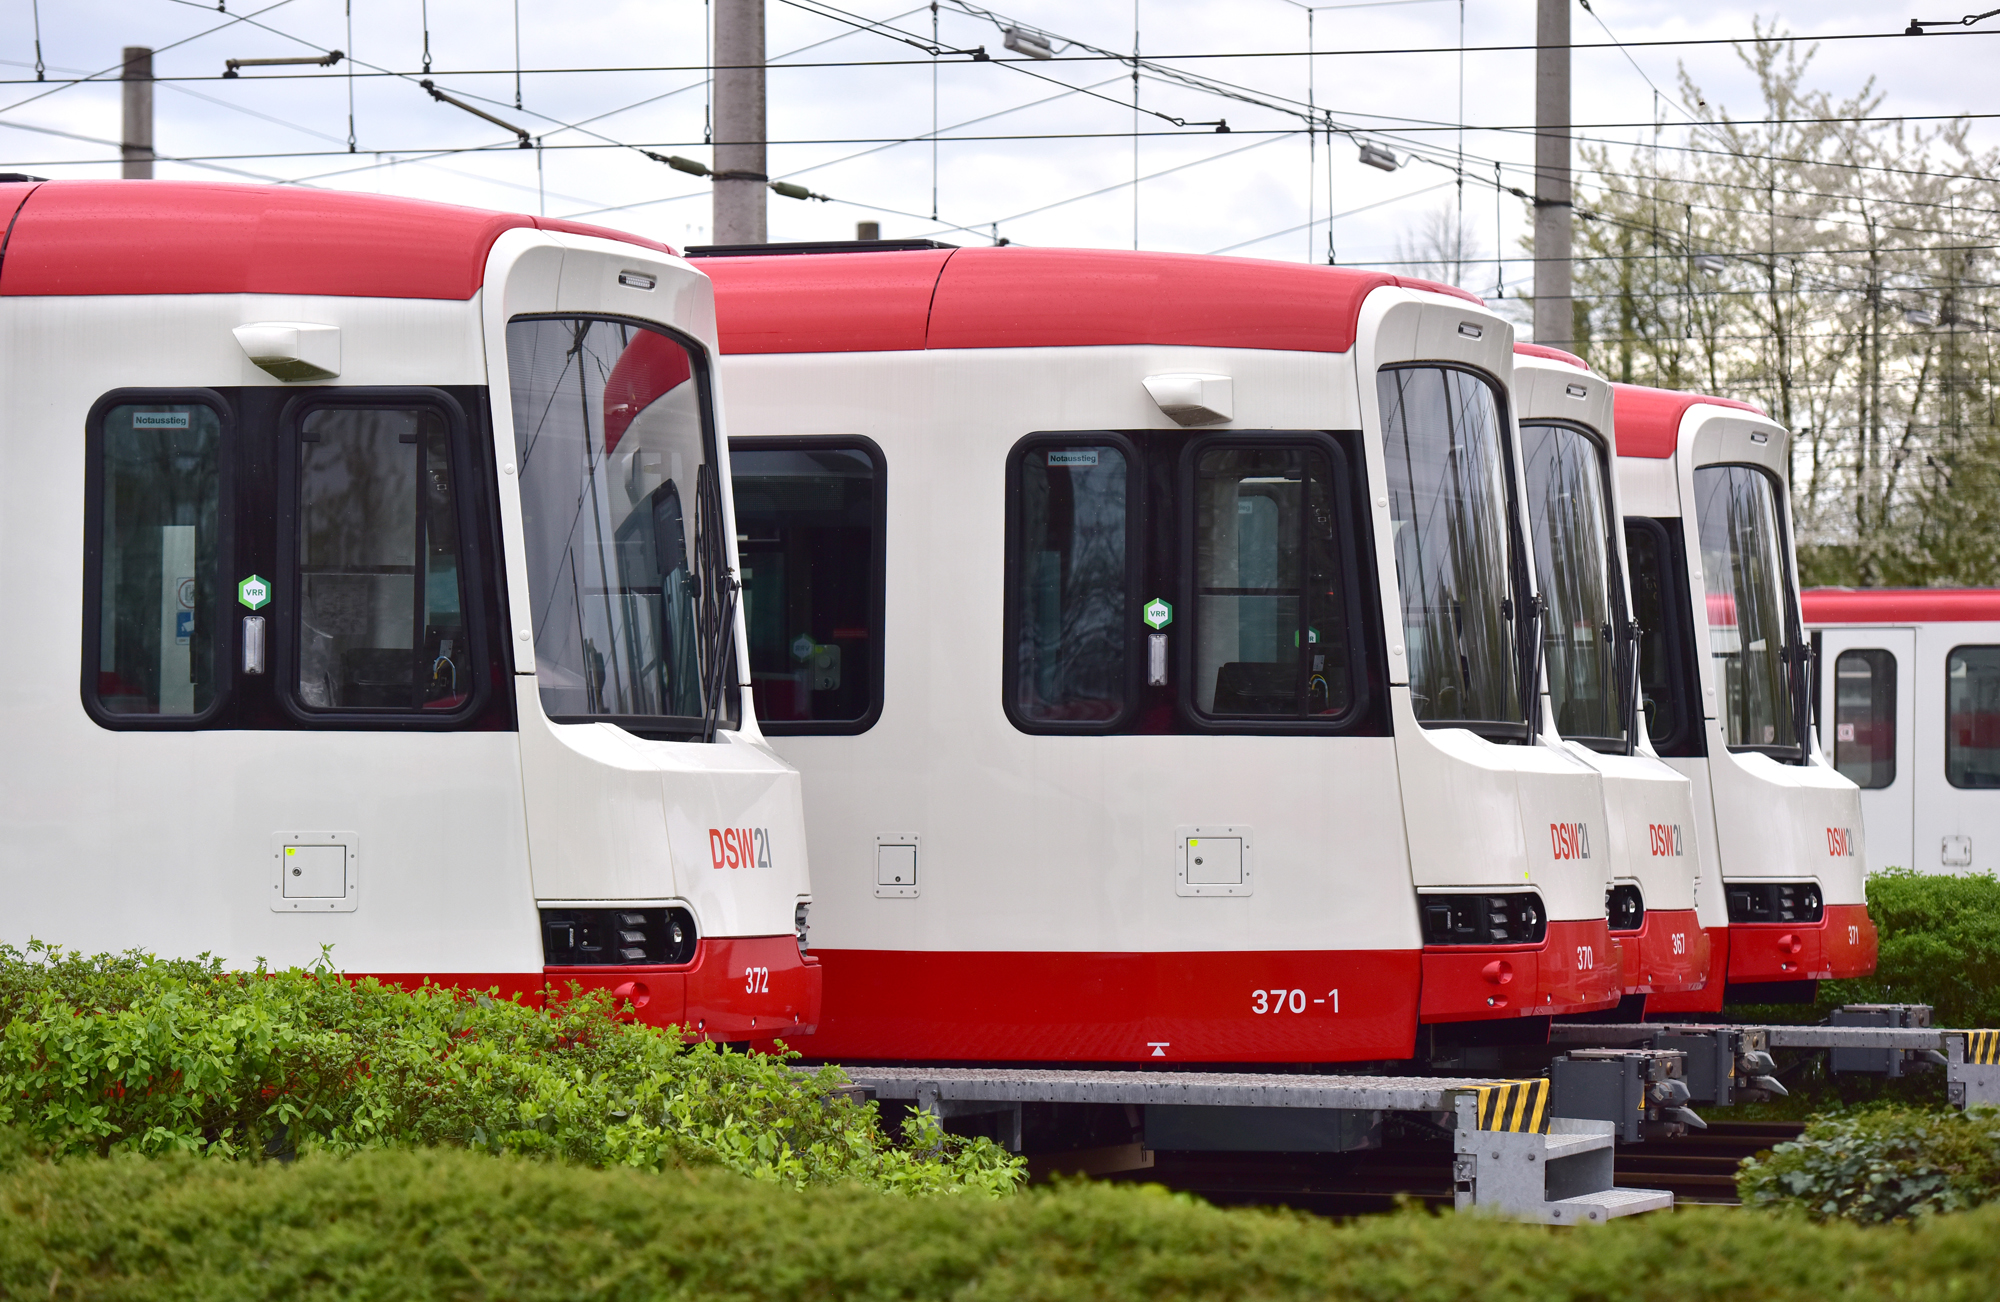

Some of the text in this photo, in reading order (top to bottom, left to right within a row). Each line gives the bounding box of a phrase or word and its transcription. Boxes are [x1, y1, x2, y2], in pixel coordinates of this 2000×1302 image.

[135, 416, 187, 426] Notausstieg
[1050, 454, 1096, 464] Notausstieg
[245, 588, 264, 596] VRR
[708, 827, 772, 870] DSW21
[1550, 822, 1591, 860] DSW21
[1649, 823, 1684, 857] DSW21
[1826, 827, 1855, 857] DSW21
[1671, 933, 1685, 955] 367
[1848, 925, 1859, 945] 371
[1577, 945, 1593, 970] 370
[745, 966, 769, 994] 372
